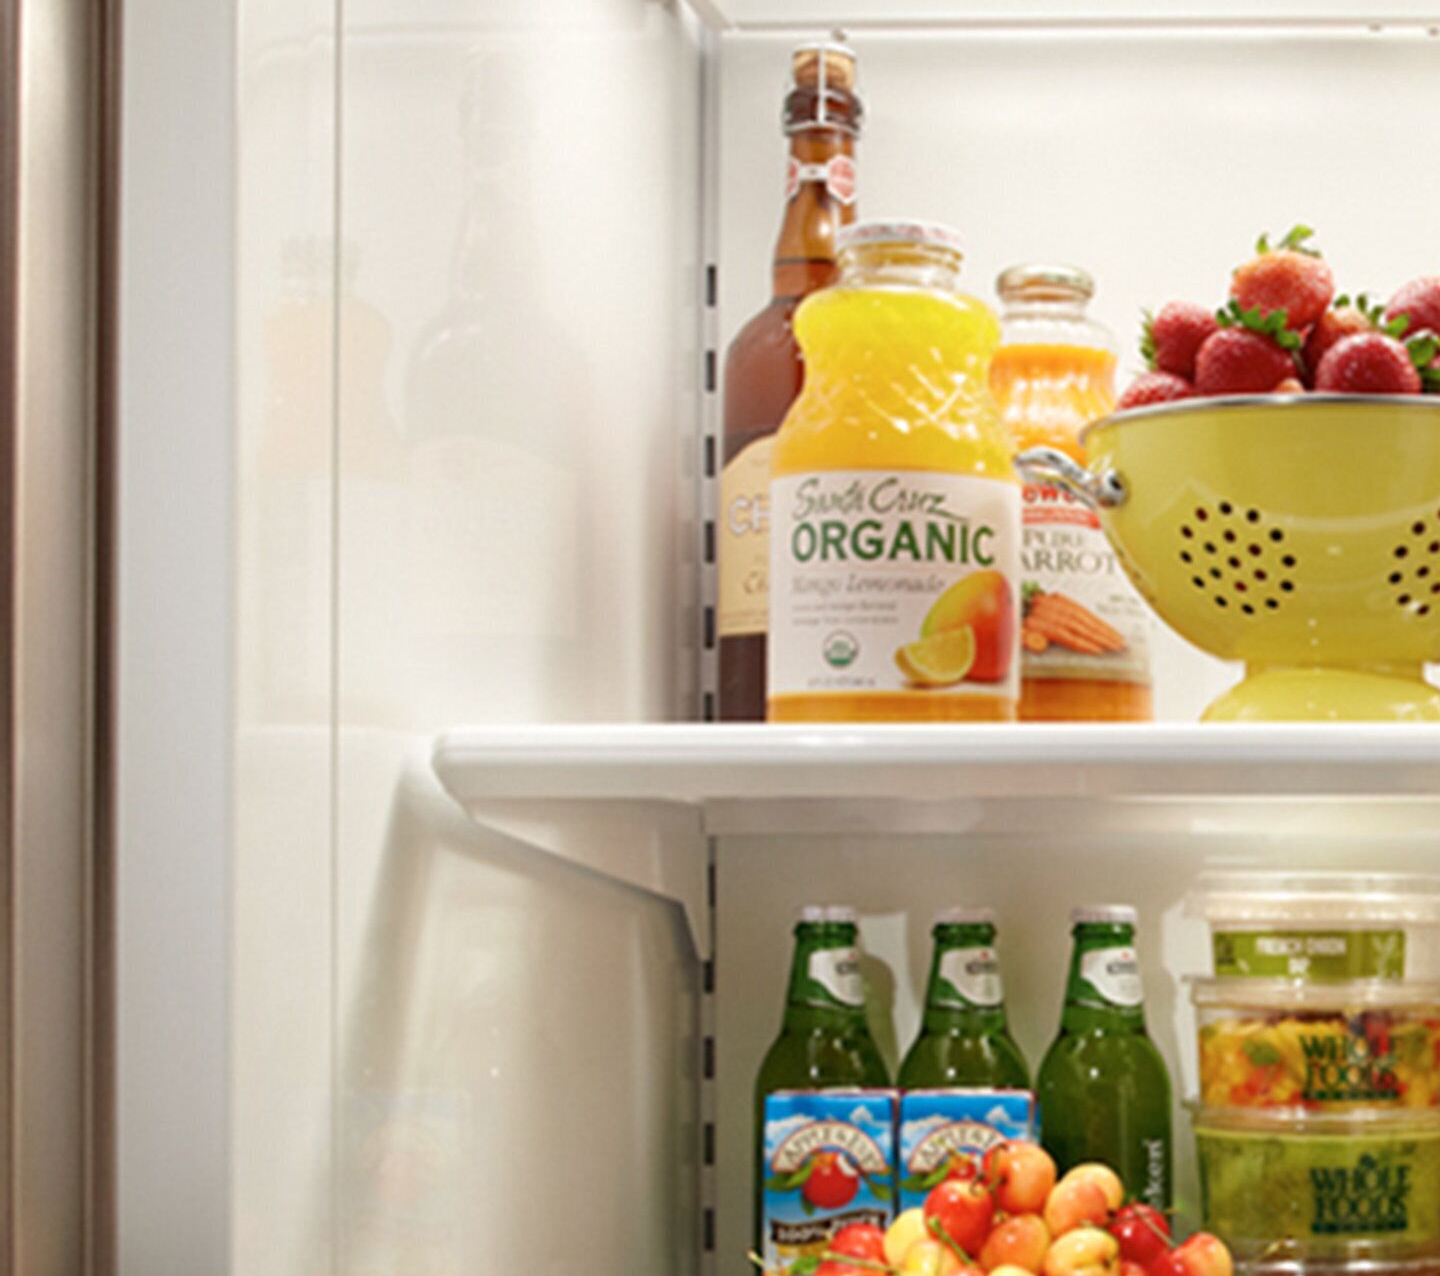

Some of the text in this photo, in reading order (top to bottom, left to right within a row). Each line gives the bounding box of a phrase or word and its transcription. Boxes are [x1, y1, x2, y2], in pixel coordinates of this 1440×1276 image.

[868, 477, 969, 522] Cruz
[791, 519, 995, 567] ORGANIC
[1309, 1163, 1412, 1197] WHOLE
[1314, 1192, 1408, 1222] FOODS
